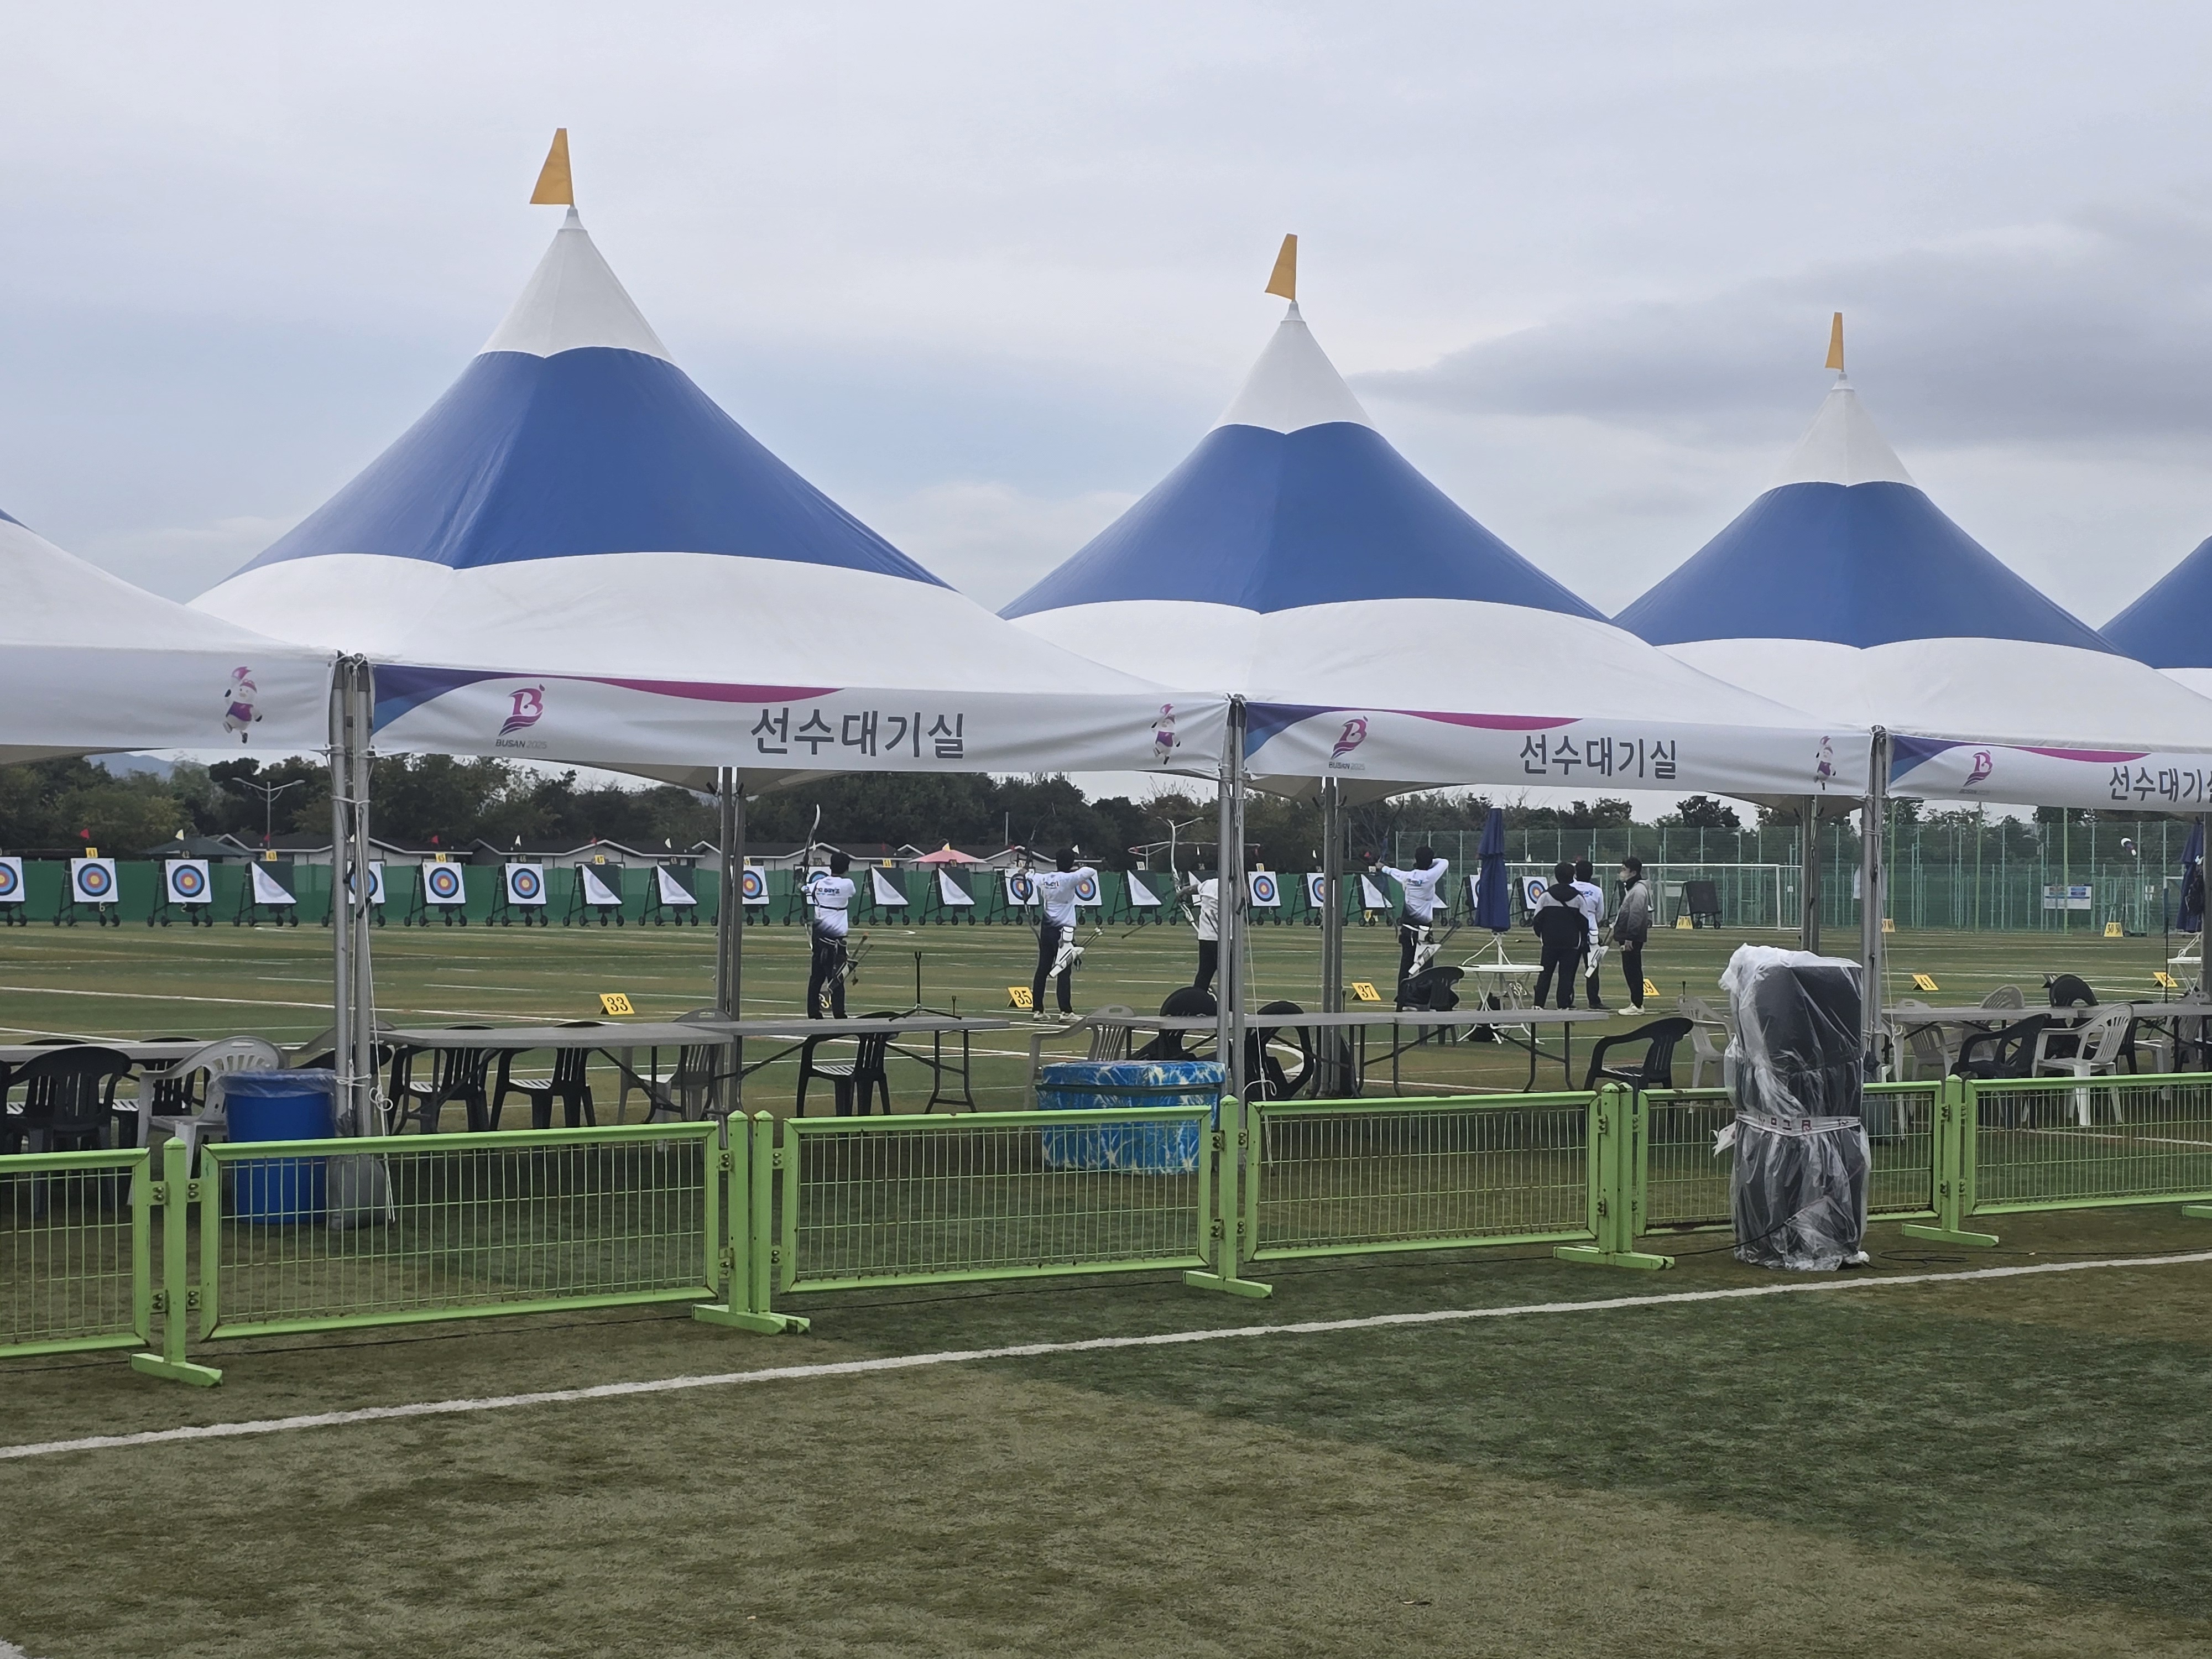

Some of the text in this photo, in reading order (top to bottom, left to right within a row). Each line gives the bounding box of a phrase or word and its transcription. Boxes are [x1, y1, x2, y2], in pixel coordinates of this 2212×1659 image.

[750, 707, 963, 759] 선수대기실
[495, 739, 525, 748] BUSAN
[1520, 734, 1676, 779] 선수대기실
[1919, 977, 1934, 988] 41
[1014, 990, 1032, 1004] 35
[1358, 985, 1374, 998] 37
[607, 997, 628, 1011] 33
